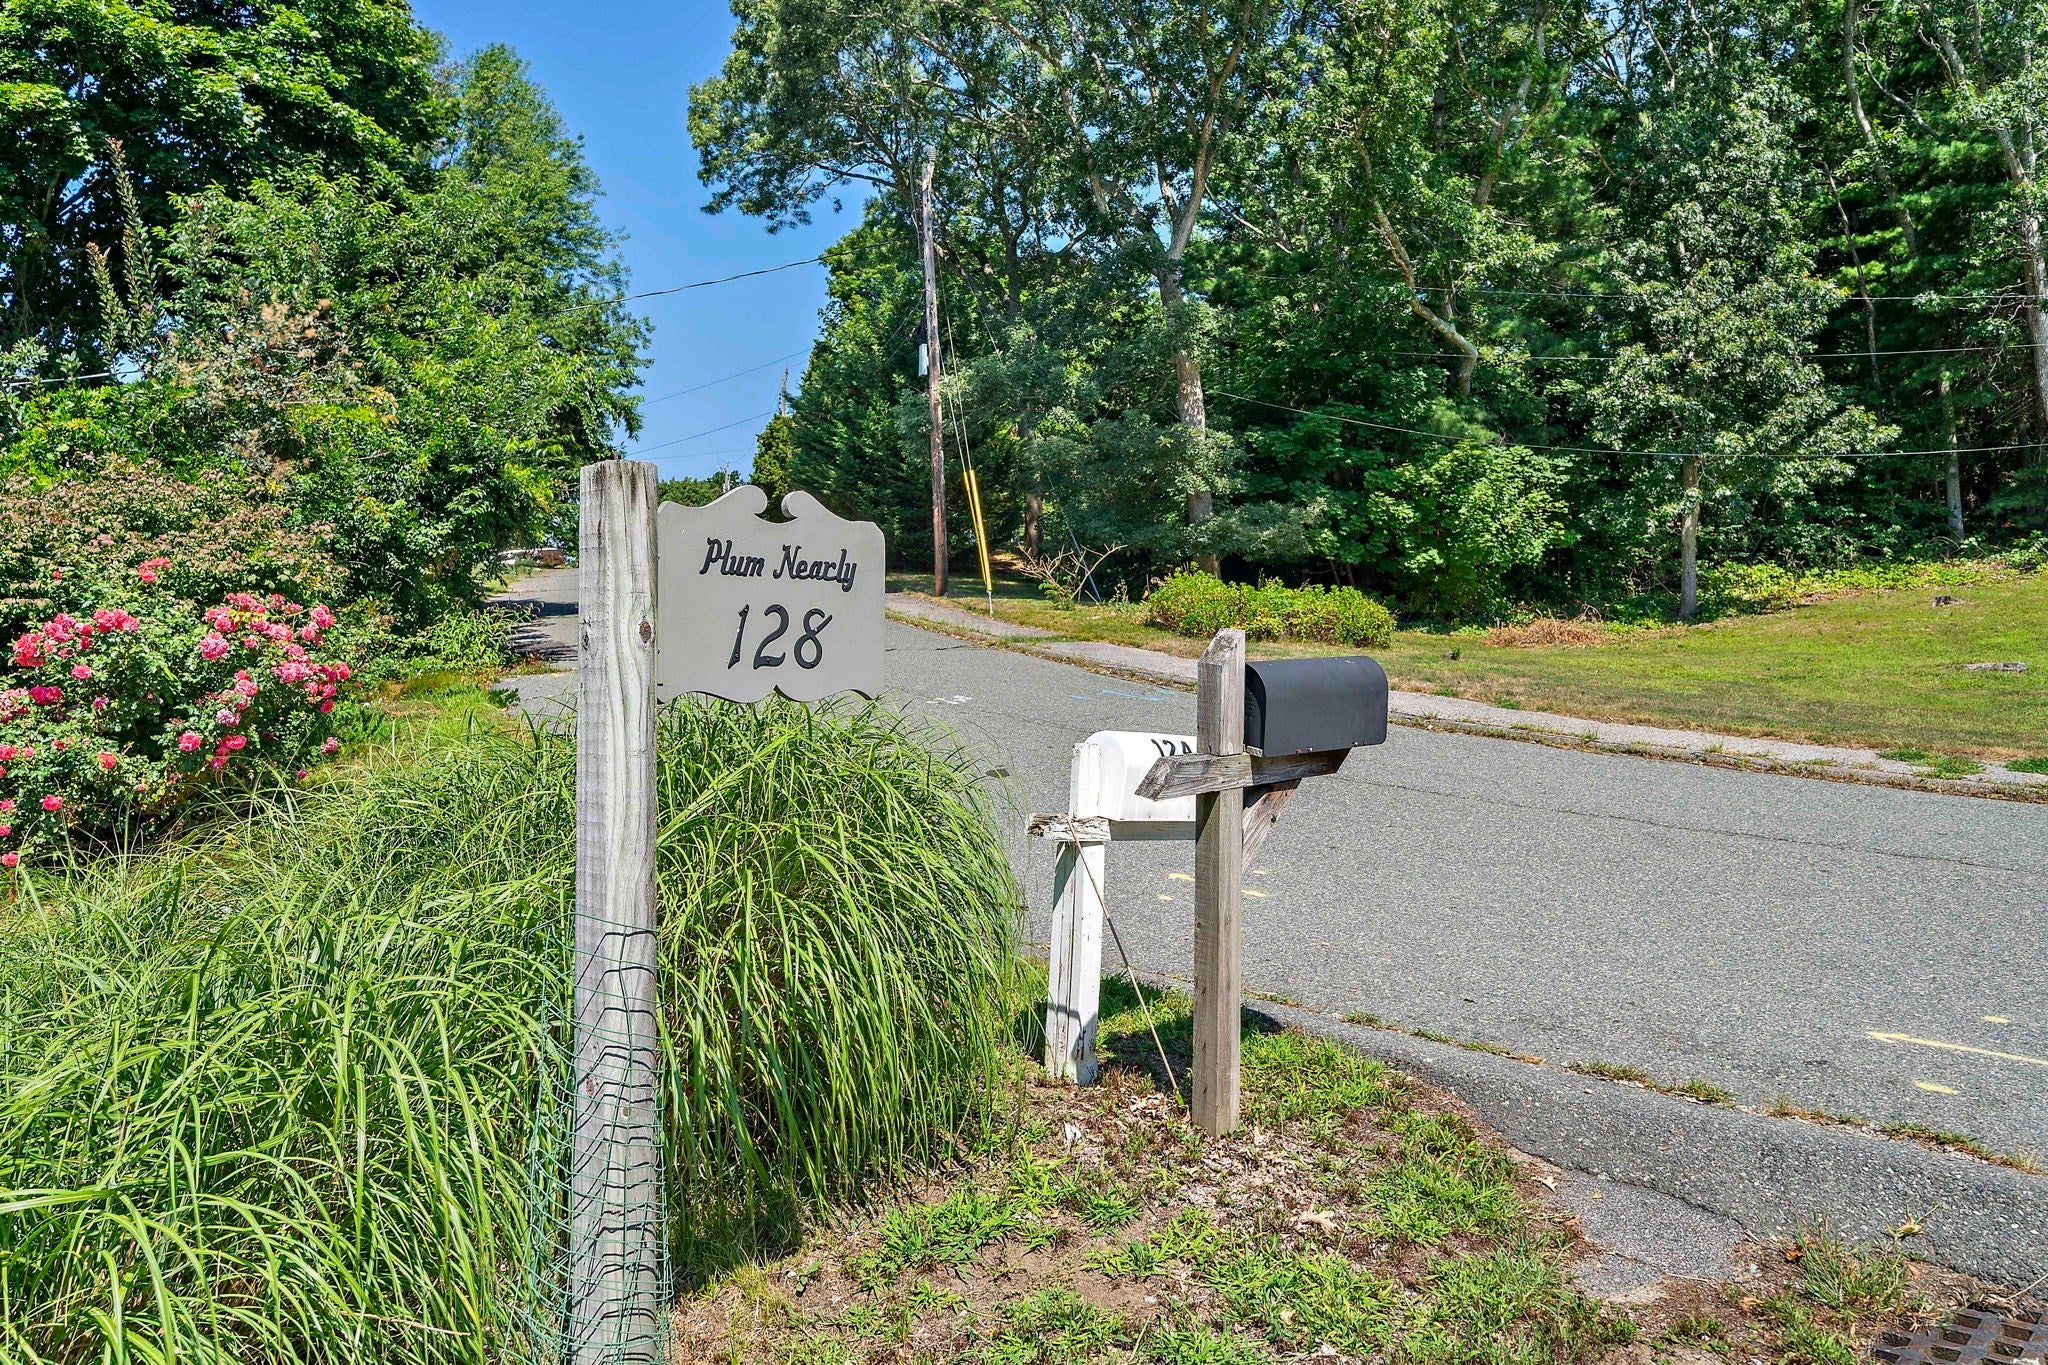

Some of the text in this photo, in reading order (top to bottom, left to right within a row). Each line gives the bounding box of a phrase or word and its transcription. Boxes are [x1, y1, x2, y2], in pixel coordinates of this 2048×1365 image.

[699, 537, 857, 592] Plum Nearly
[727, 603, 833, 670] 128
